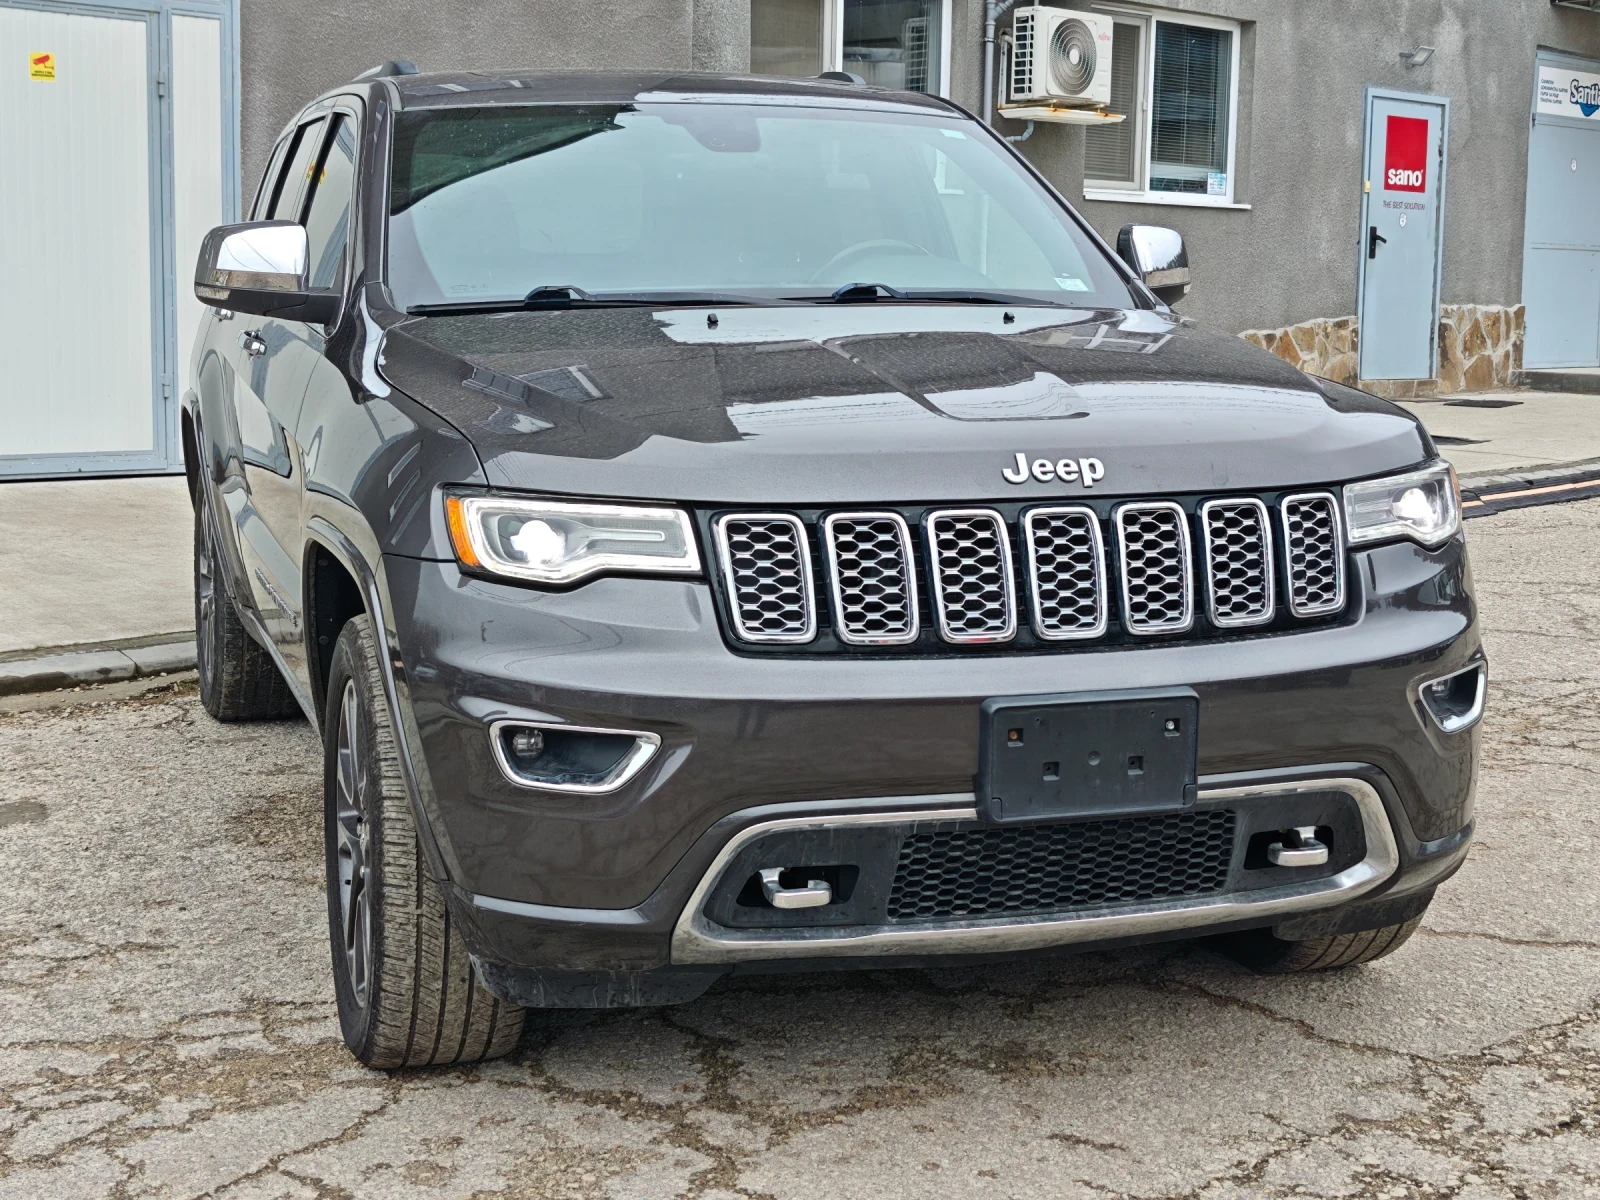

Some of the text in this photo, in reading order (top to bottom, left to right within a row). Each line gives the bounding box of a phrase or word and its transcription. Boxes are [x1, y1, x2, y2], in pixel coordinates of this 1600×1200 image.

[1388, 168, 1422, 187] sano
[1383, 200, 1426, 211] THE BEST SOLUTION
[1002, 453, 1105, 488] Jeep
